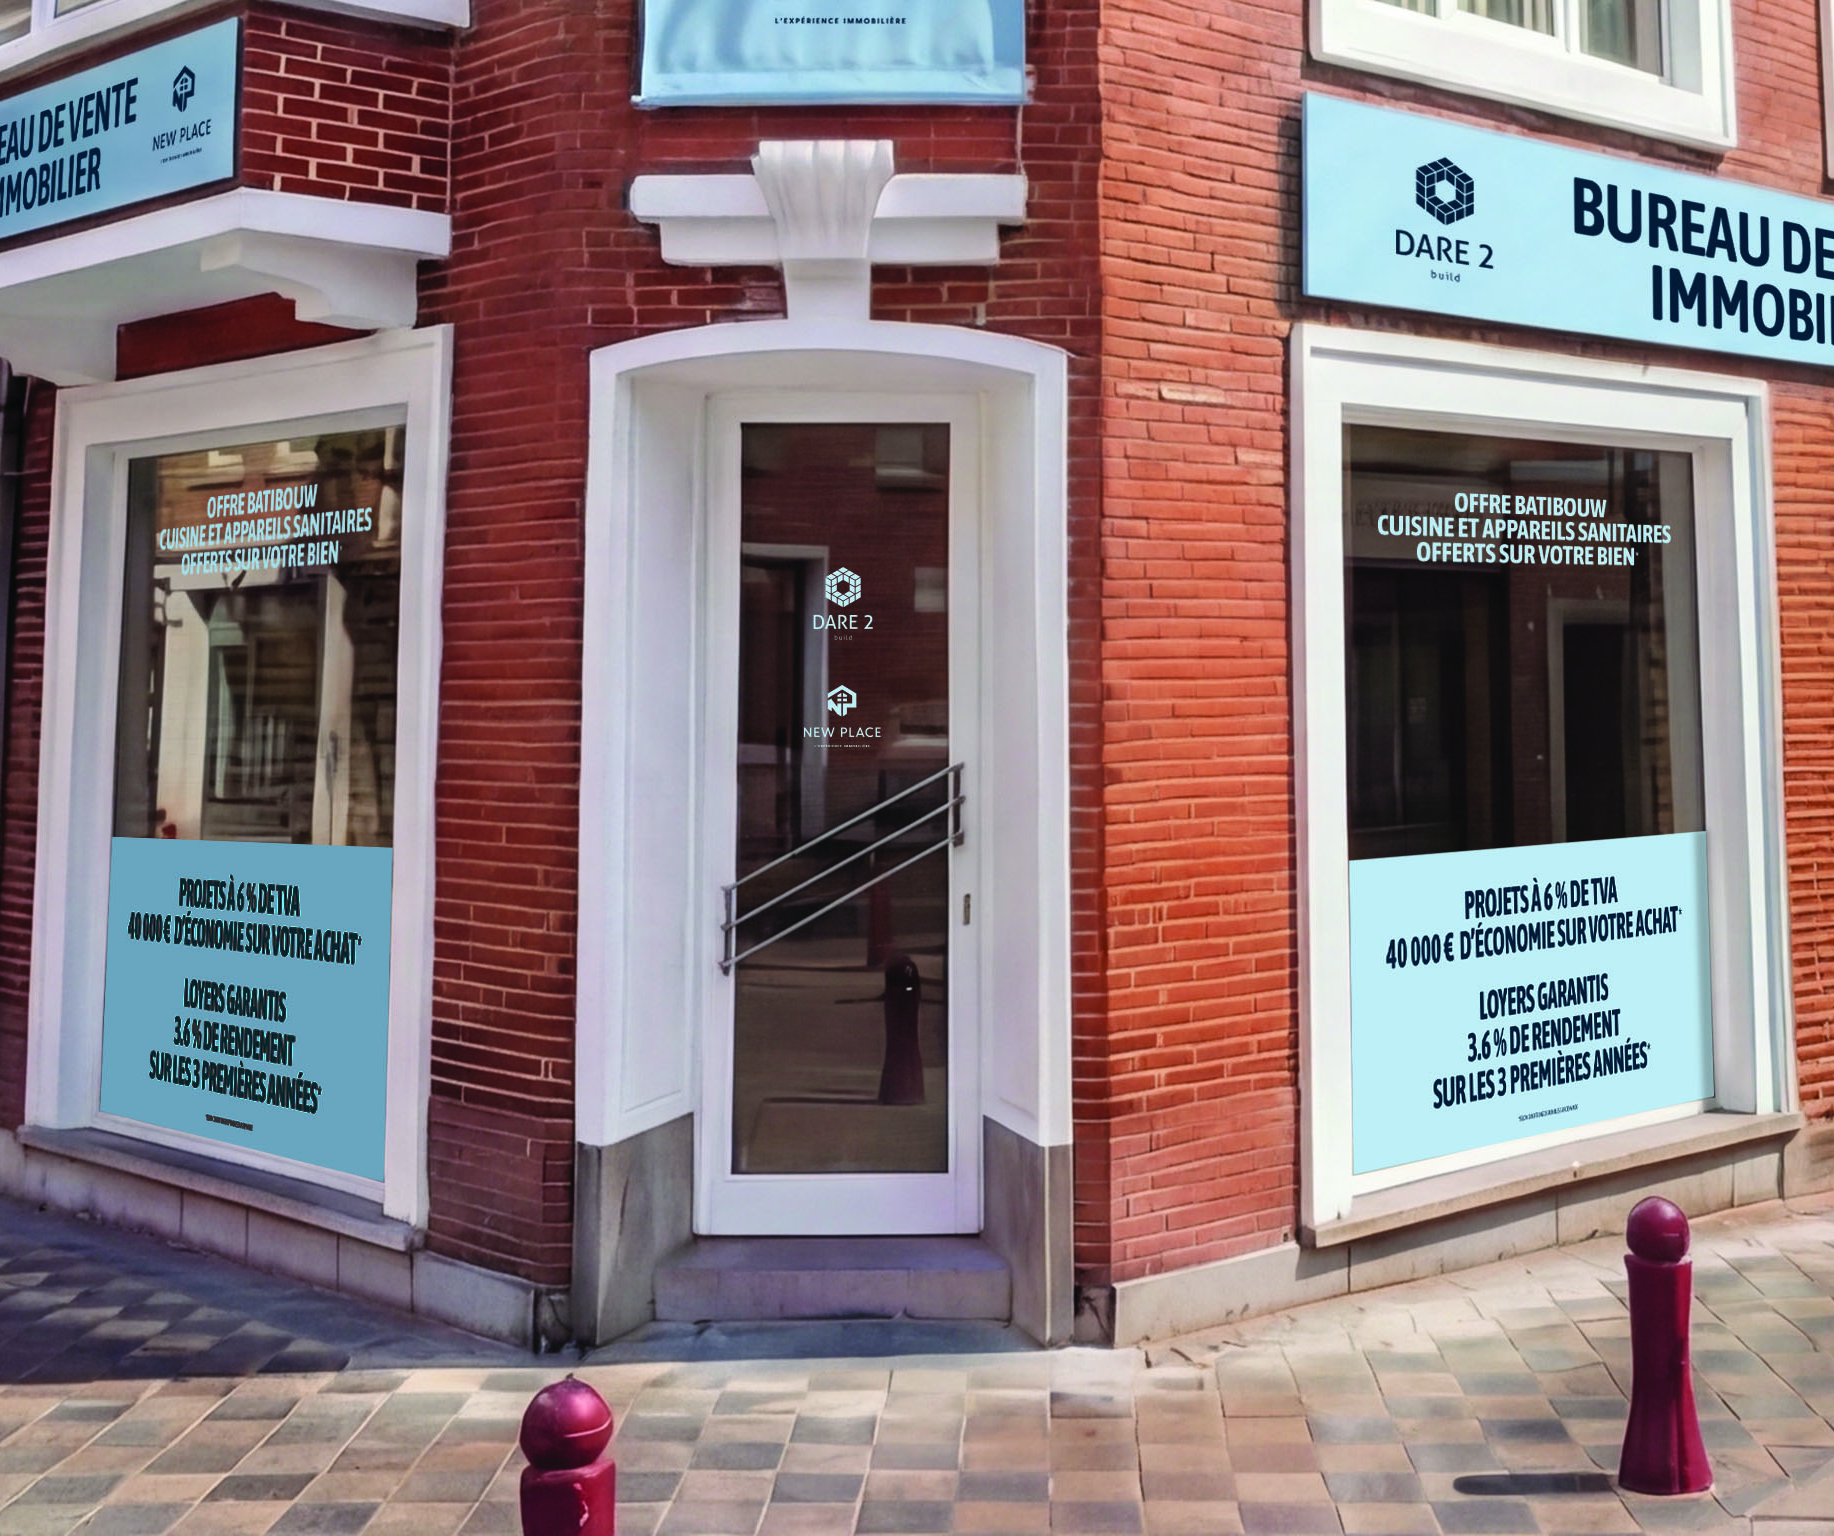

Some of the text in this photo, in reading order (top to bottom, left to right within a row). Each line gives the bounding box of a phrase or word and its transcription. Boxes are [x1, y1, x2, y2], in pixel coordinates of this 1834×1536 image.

[774, 16, 907, 25] L'EXPÉRIENCE IMMOBILIÈRE
[38, 103, 66, 153] DE
[69, 77, 139, 142] VENTE
[152, 119, 212, 152] NEW PLACE
[1573, 176, 1770, 267] BUREAU
[1395, 229, 1494, 270] DARE 2
[1430, 270, 1461, 283] build
[207, 484, 318, 519] OFFRE BATIBOUW
[1454, 492, 1511, 514] OFFRE
[1515, 496, 1607, 518] BATIBOUW
[159, 507, 372, 550] CUISINE ET APPAREILS SANITAIRES
[1377, 515, 1672, 544] CUISINE ET APPAREILS SANITAIRES
[181, 549, 233, 576] OFFERTS
[234, 548, 260, 571] SUR
[262, 544, 305, 568] VOTRE
[1416, 541, 1496, 564] OFFERTS
[1498, 544, 1535, 564] SUR
[1539, 545, 1594, 565] VOTRE
[812, 615, 874, 630] DARE 2
[803, 727, 882, 738] NEW PLACE
[179, 874, 301, 917] PROJETS À 6 % DE TVA
[1464, 876, 1618, 920] PROJETS À 6 % DE TVA
[128, 912, 142, 940] 40
[143, 913, 163, 942] 000
[163, 916, 171, 944] €
[174, 911, 244, 952] D'ÉCONOMIE
[245, 923, 272, 955] SUR
[272, 925, 313, 960] VOTRE
[1385, 938, 1407, 969] 40
[1411, 934, 1441, 966] 000
[1444, 932, 1455, 962] €
[1460, 920, 1556, 960] D'ÉCONOMIE
[1557, 916, 1586, 947] SUR
[1588, 911, 1634, 944] VOTRE
[183, 978, 287, 1023] LOYERS GARANTIS
[1479, 973, 1609, 1020] LOYERS GARANTIS
[173, 1016, 296, 1066] 3.6 % DE RENDEMENT
[1467, 1009, 1621, 1062] 3.6 % DE RENDEMENT
[149, 1050, 173, 1083] SUR
[172, 1054, 191, 1087] LES
[192, 1059, 200, 1089] 3
[201, 1061, 266, 1103] PREMIÈRES
[1433, 1074, 1466, 1110] SUR
[1469, 1069, 1496, 1103] LES
[1497, 1067, 1507, 1097] 3
[1510, 1050, 1591, 1094] PREMIÈRES
